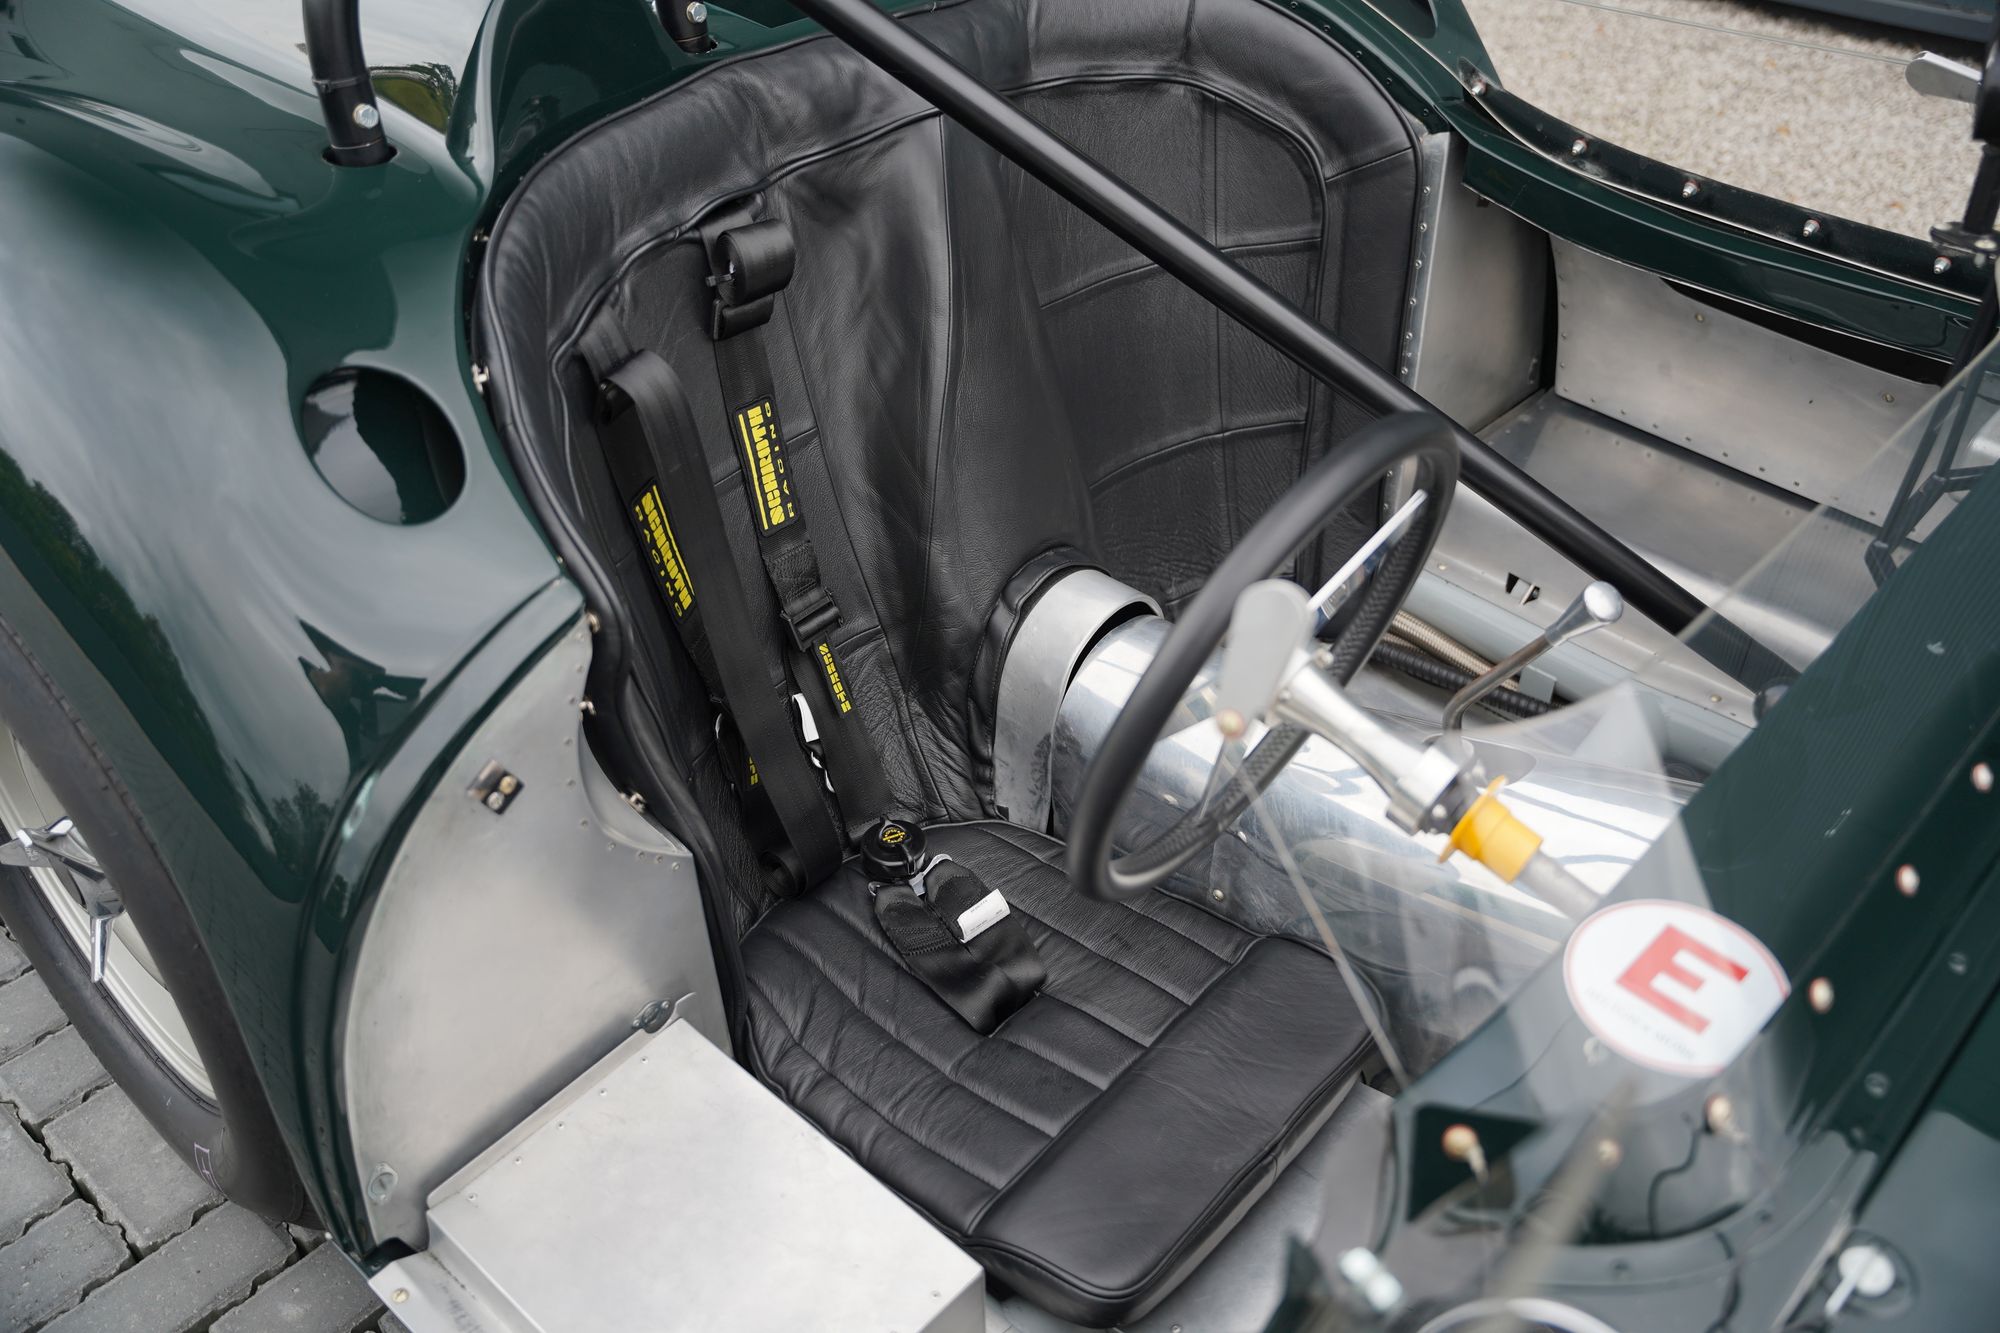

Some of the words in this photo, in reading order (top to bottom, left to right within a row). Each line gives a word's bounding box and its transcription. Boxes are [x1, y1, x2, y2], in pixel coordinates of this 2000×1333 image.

[747, 405, 785, 526] SCHROTH
[764, 401, 796, 518] RACING
[634, 505, 683, 618] RACING
[641, 491, 693, 610] SCHROTH
[819, 643, 852, 714] SCHROTH
[1615, 923, 1749, 1035] E
